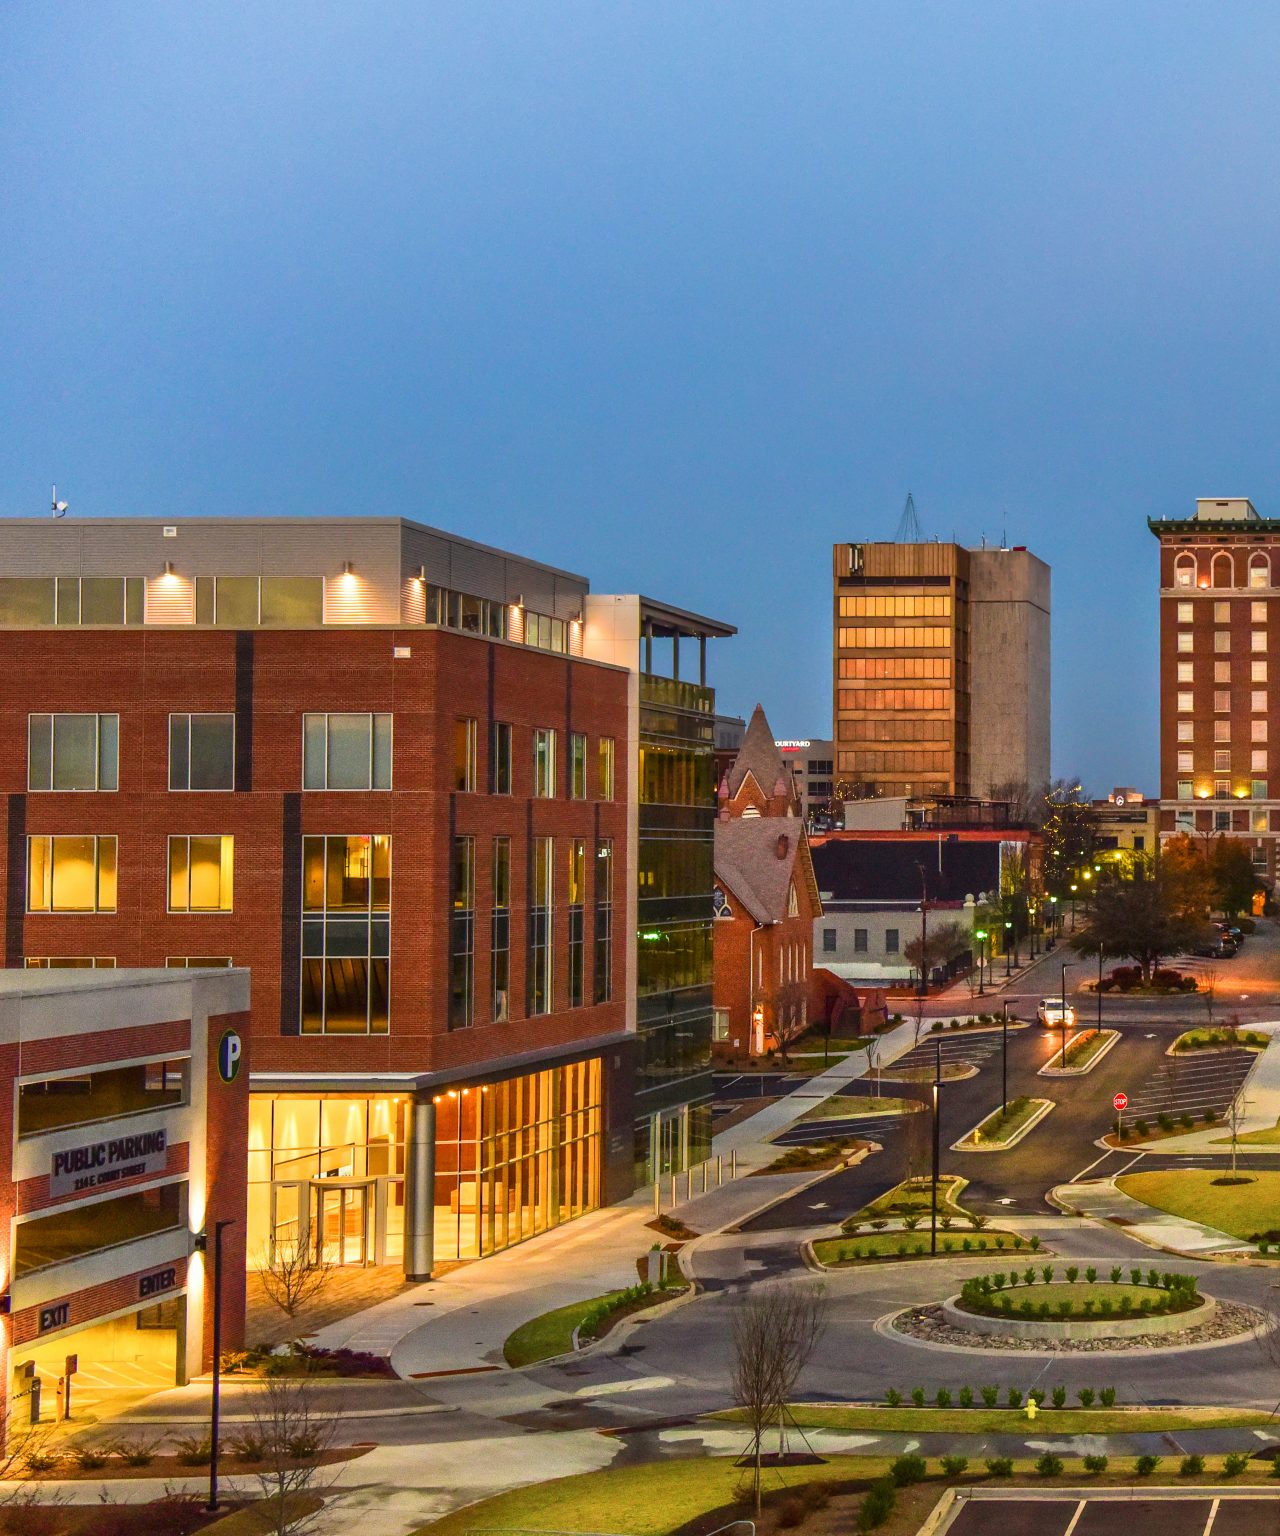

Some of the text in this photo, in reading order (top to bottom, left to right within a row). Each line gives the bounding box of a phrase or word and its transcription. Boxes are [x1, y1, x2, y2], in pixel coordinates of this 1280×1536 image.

[226, 1035, 241, 1078] P
[54, 1131, 165, 1177] PUBLIC PARKING
[121, 1163, 146, 1179] STREET
[139, 1267, 176, 1297] ENTER
[40, 1302, 69, 1331] EXIT
